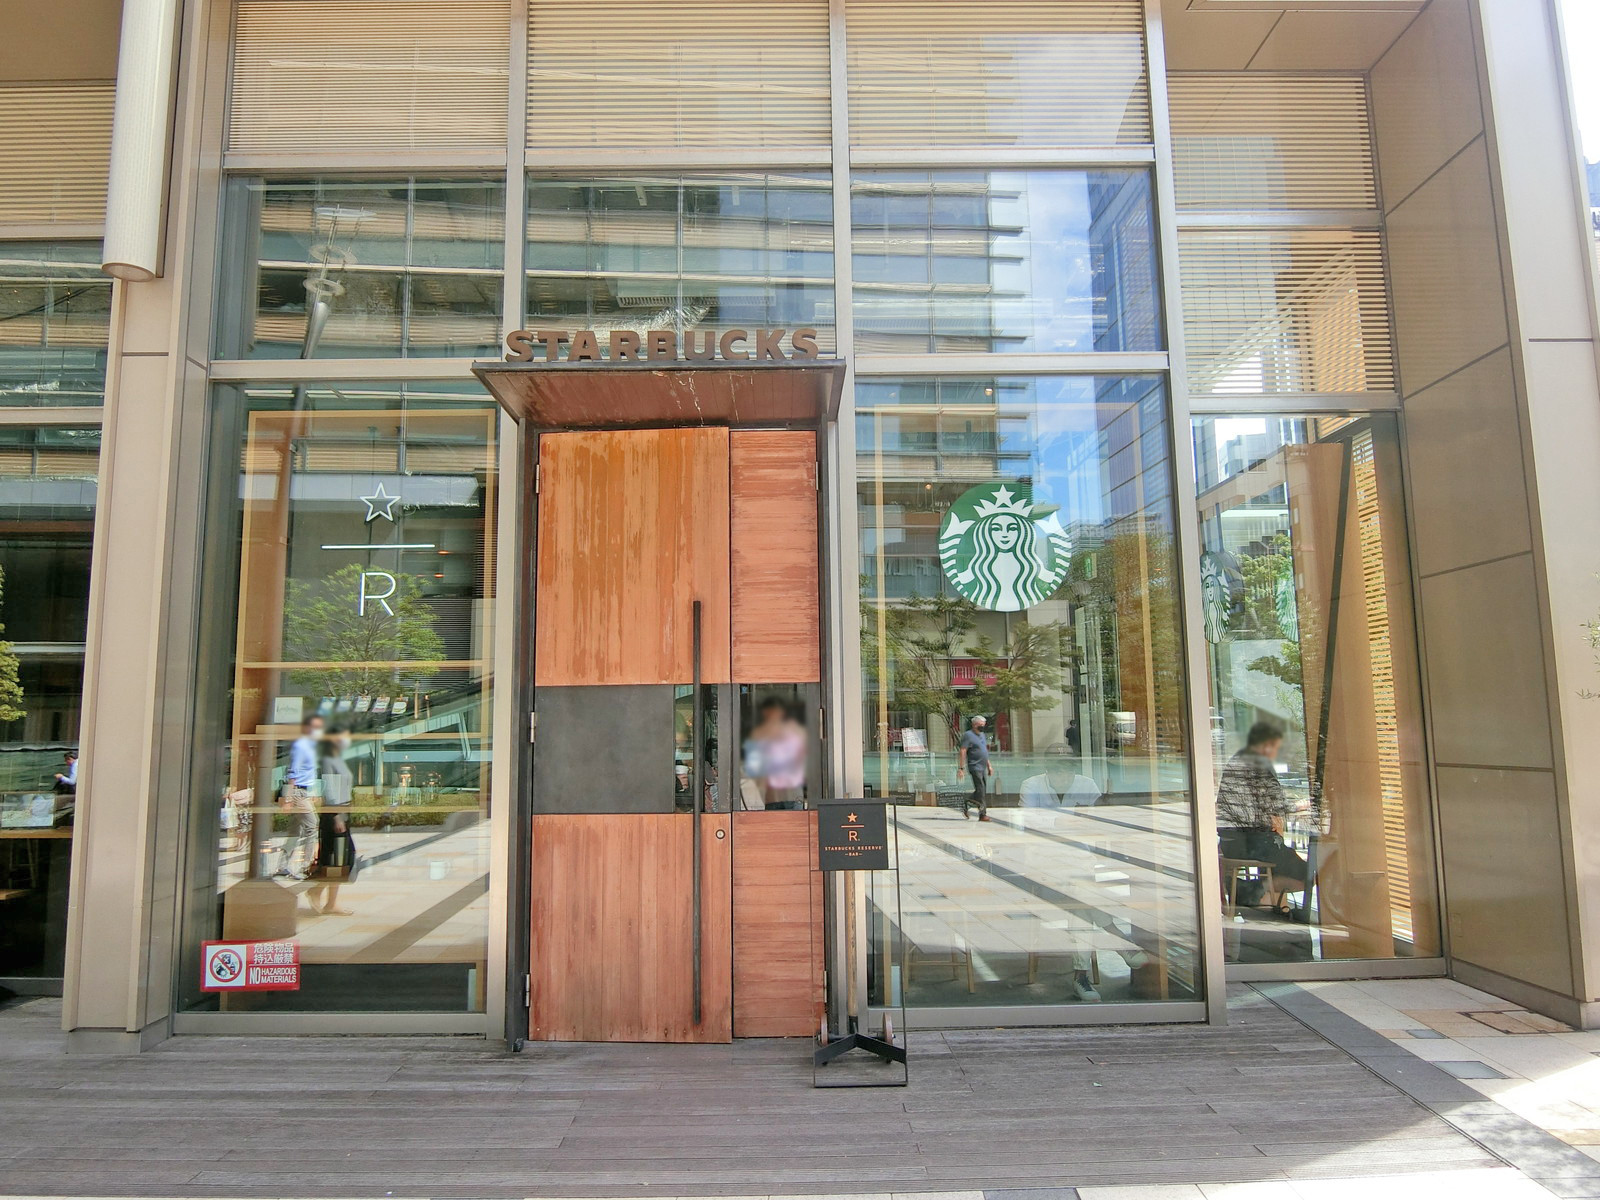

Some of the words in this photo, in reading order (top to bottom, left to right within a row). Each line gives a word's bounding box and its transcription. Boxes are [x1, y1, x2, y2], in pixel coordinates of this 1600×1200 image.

[505, 329, 819, 361] STARBUCKS
[359, 572, 396, 616] R
[254, 943, 294, 953] 危険物品
[254, 954, 294, 964] 持込厳禁
[249, 967, 260, 984] NO
[261, 967, 296, 975] HAZARDOUS
[261, 975, 296, 983] MATERIALS
